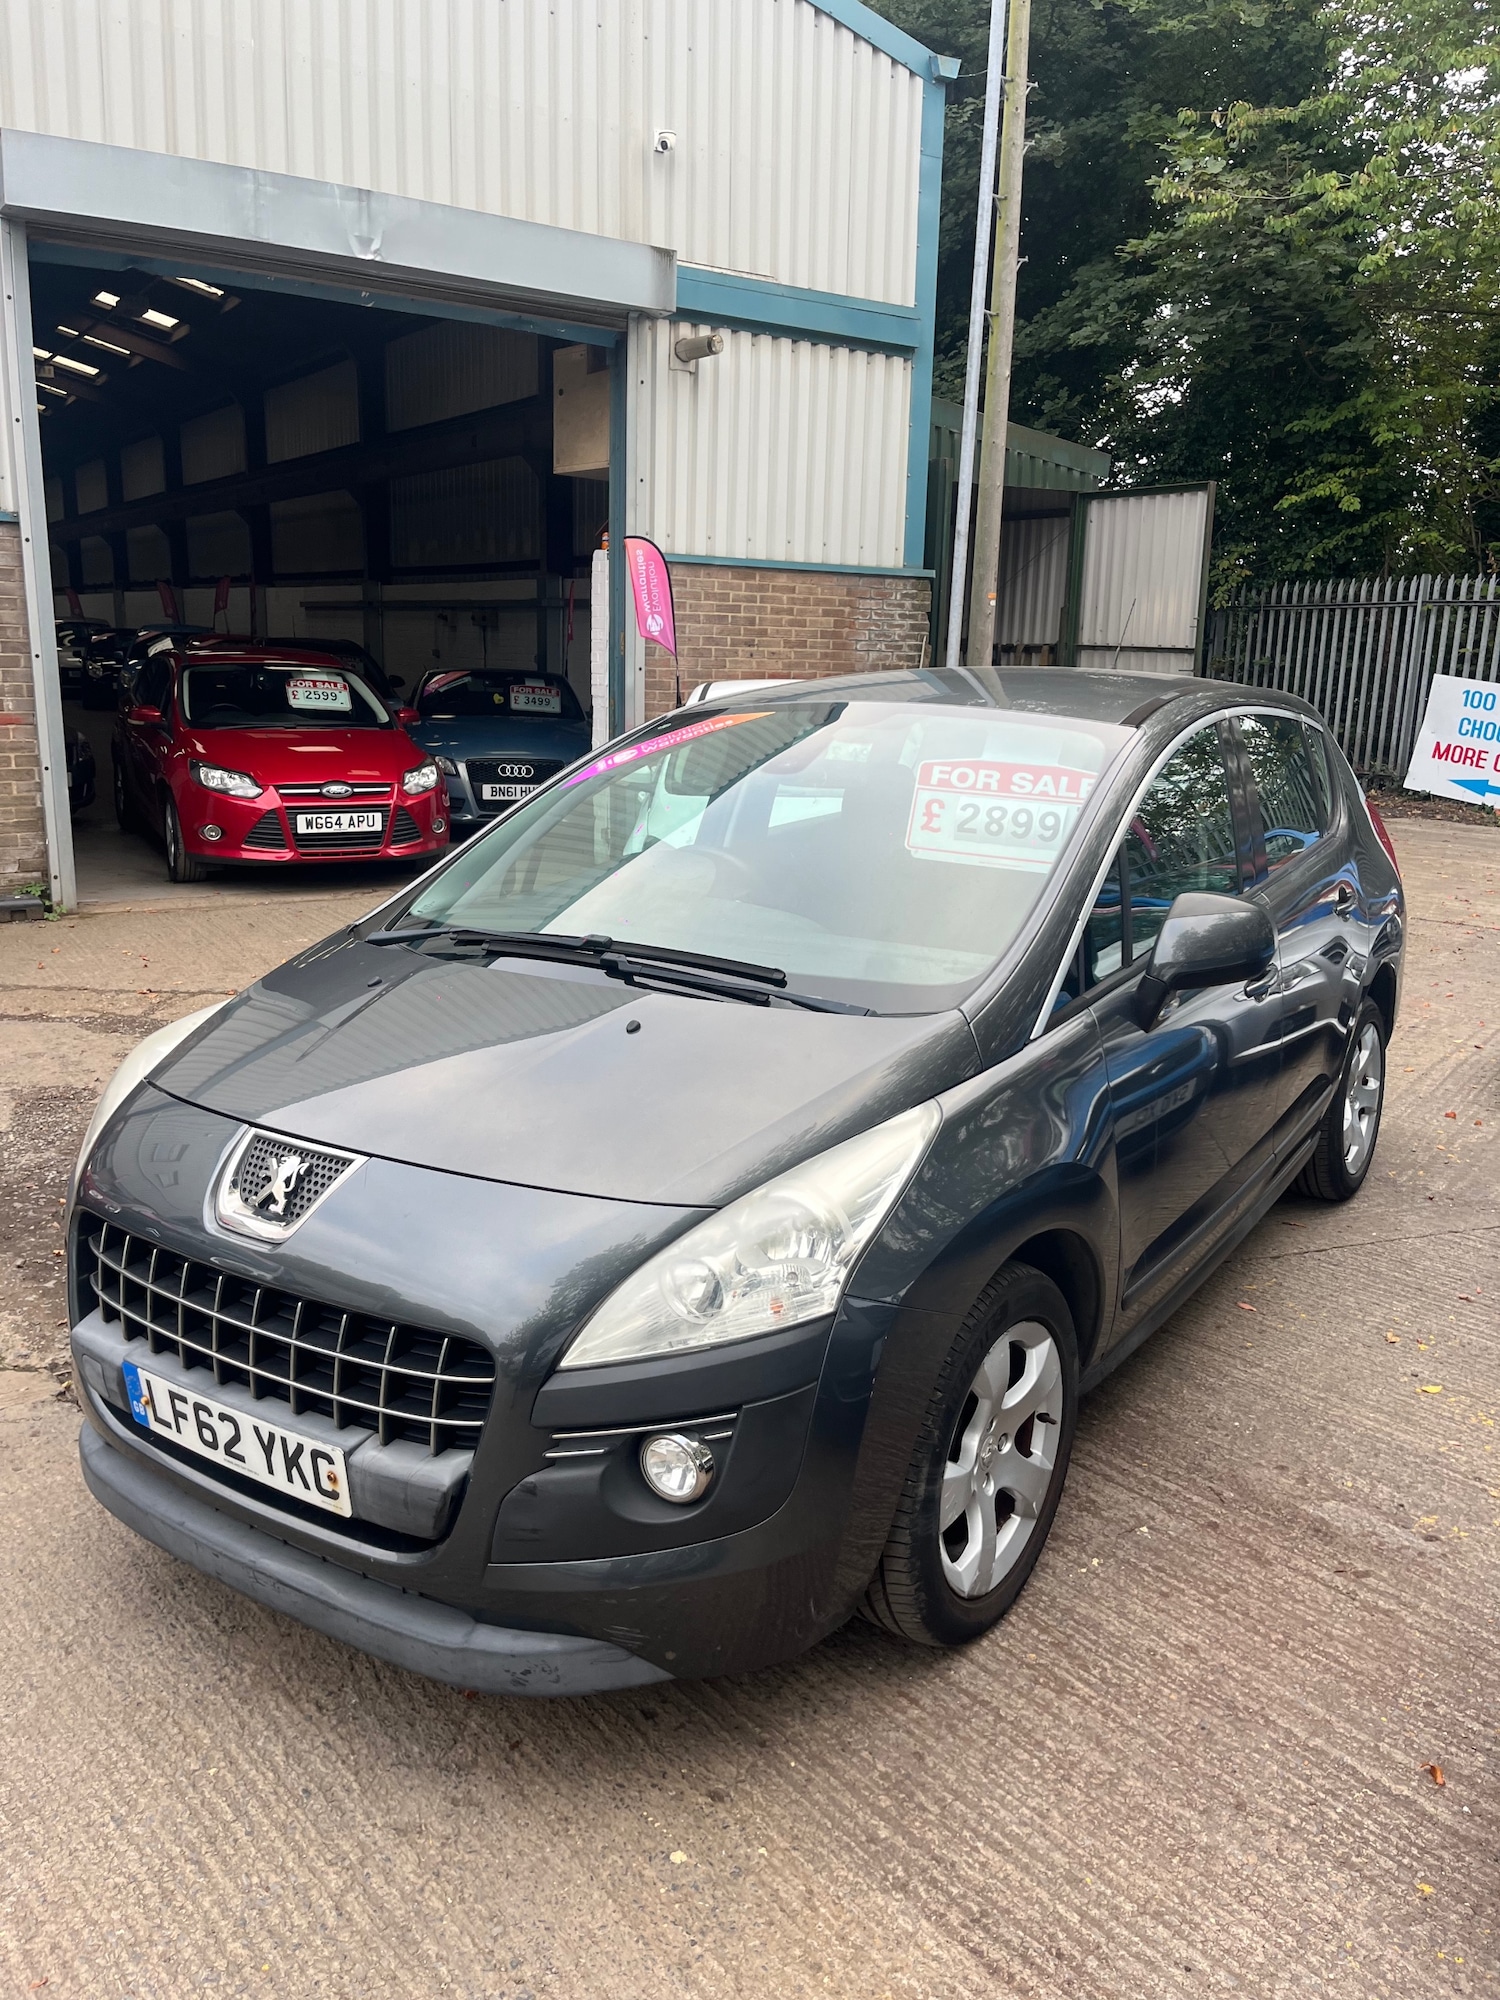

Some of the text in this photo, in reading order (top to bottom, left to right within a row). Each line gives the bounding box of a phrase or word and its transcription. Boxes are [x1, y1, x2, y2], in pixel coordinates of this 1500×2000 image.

[290, 680, 344, 690] FOR SALE
[513, 686, 557, 696] FOR SALE
[291, 690, 338, 701] £ 2599
[513, 695, 551, 706] £ 3499
[1462, 689, 1497, 711] 100
[1431, 741, 1489, 769] MORE
[930, 765, 1098, 799] FOR SALE
[490, 786, 517, 798] BN61
[305, 814, 375, 830] WG64 APU
[920, 798, 1062, 843] £ 2899
[133, 1400, 146, 1416] GB
[145, 1378, 340, 1501] LF62 YKC
